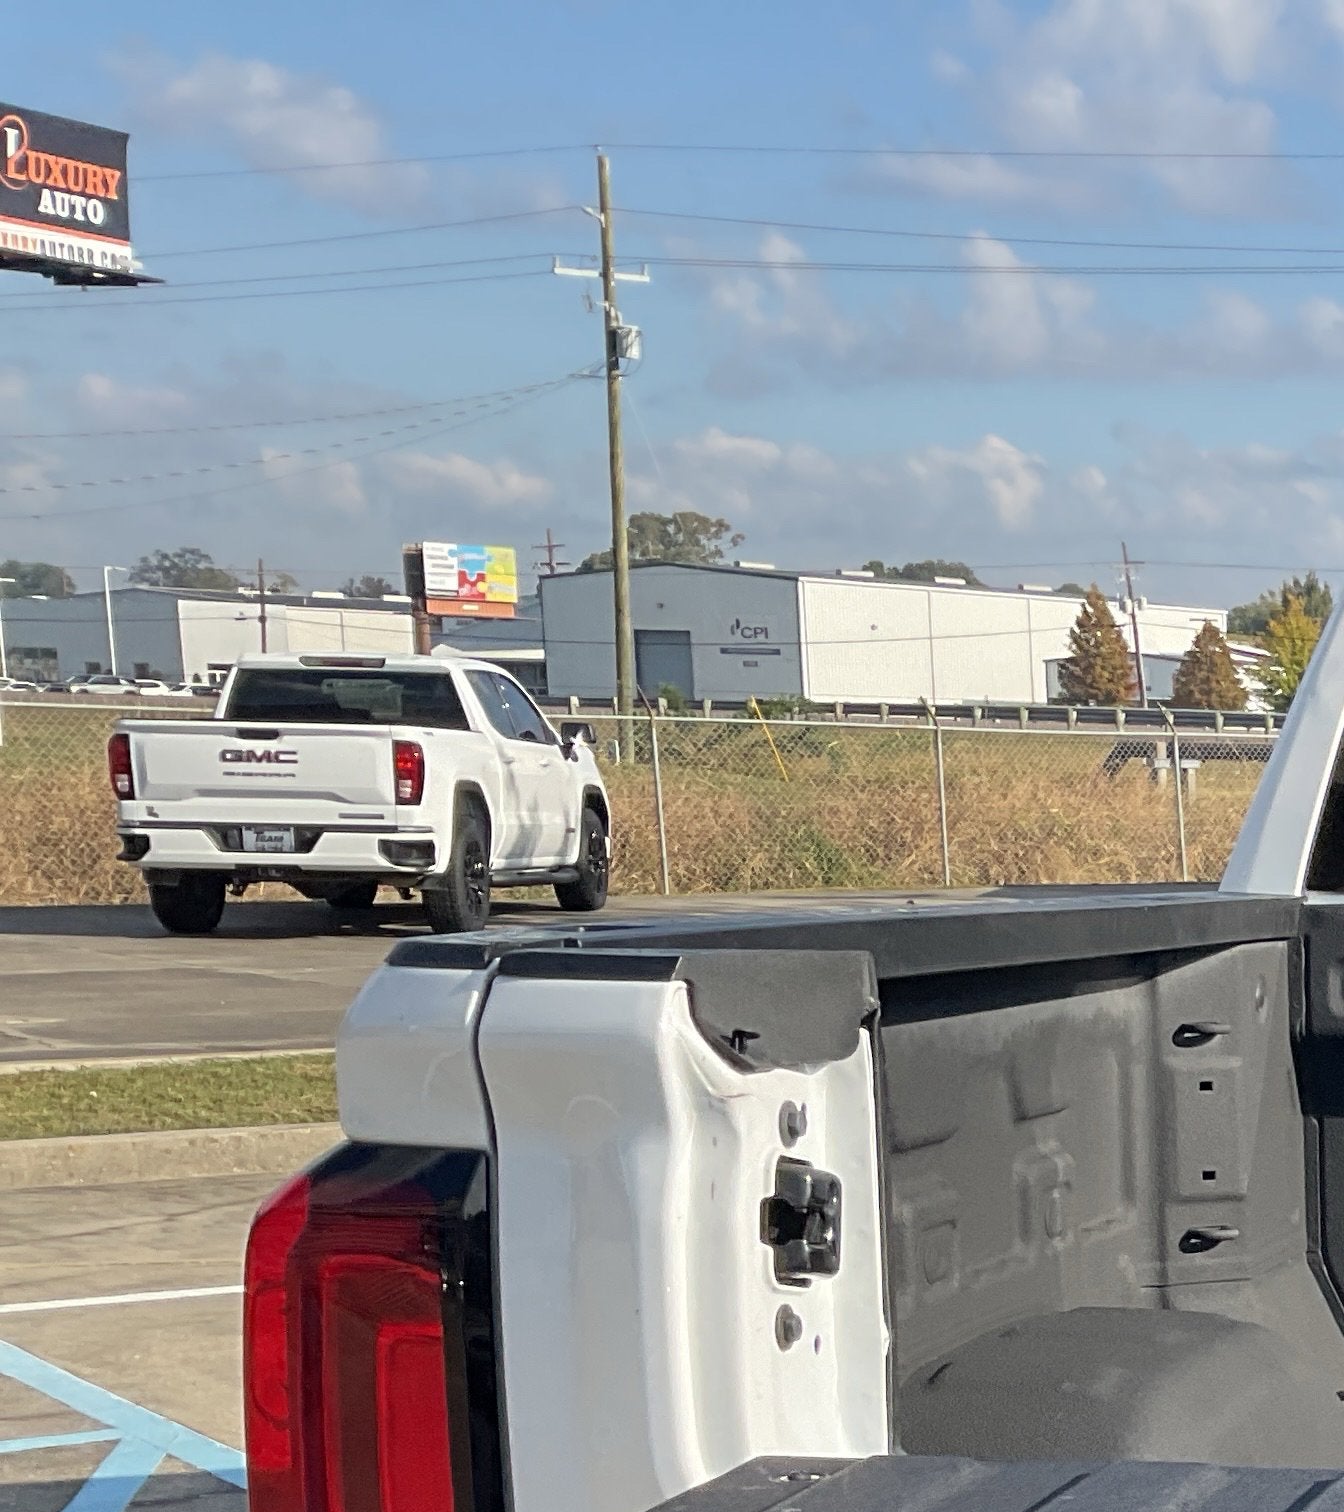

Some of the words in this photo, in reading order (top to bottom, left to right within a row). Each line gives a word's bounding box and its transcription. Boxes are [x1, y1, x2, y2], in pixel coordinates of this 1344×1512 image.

[3, 127, 121, 199] LUXURY
[37, 188, 104, 225] AUTO
[740, 626, 769, 639] CPI
[219, 749, 298, 764] GMC
